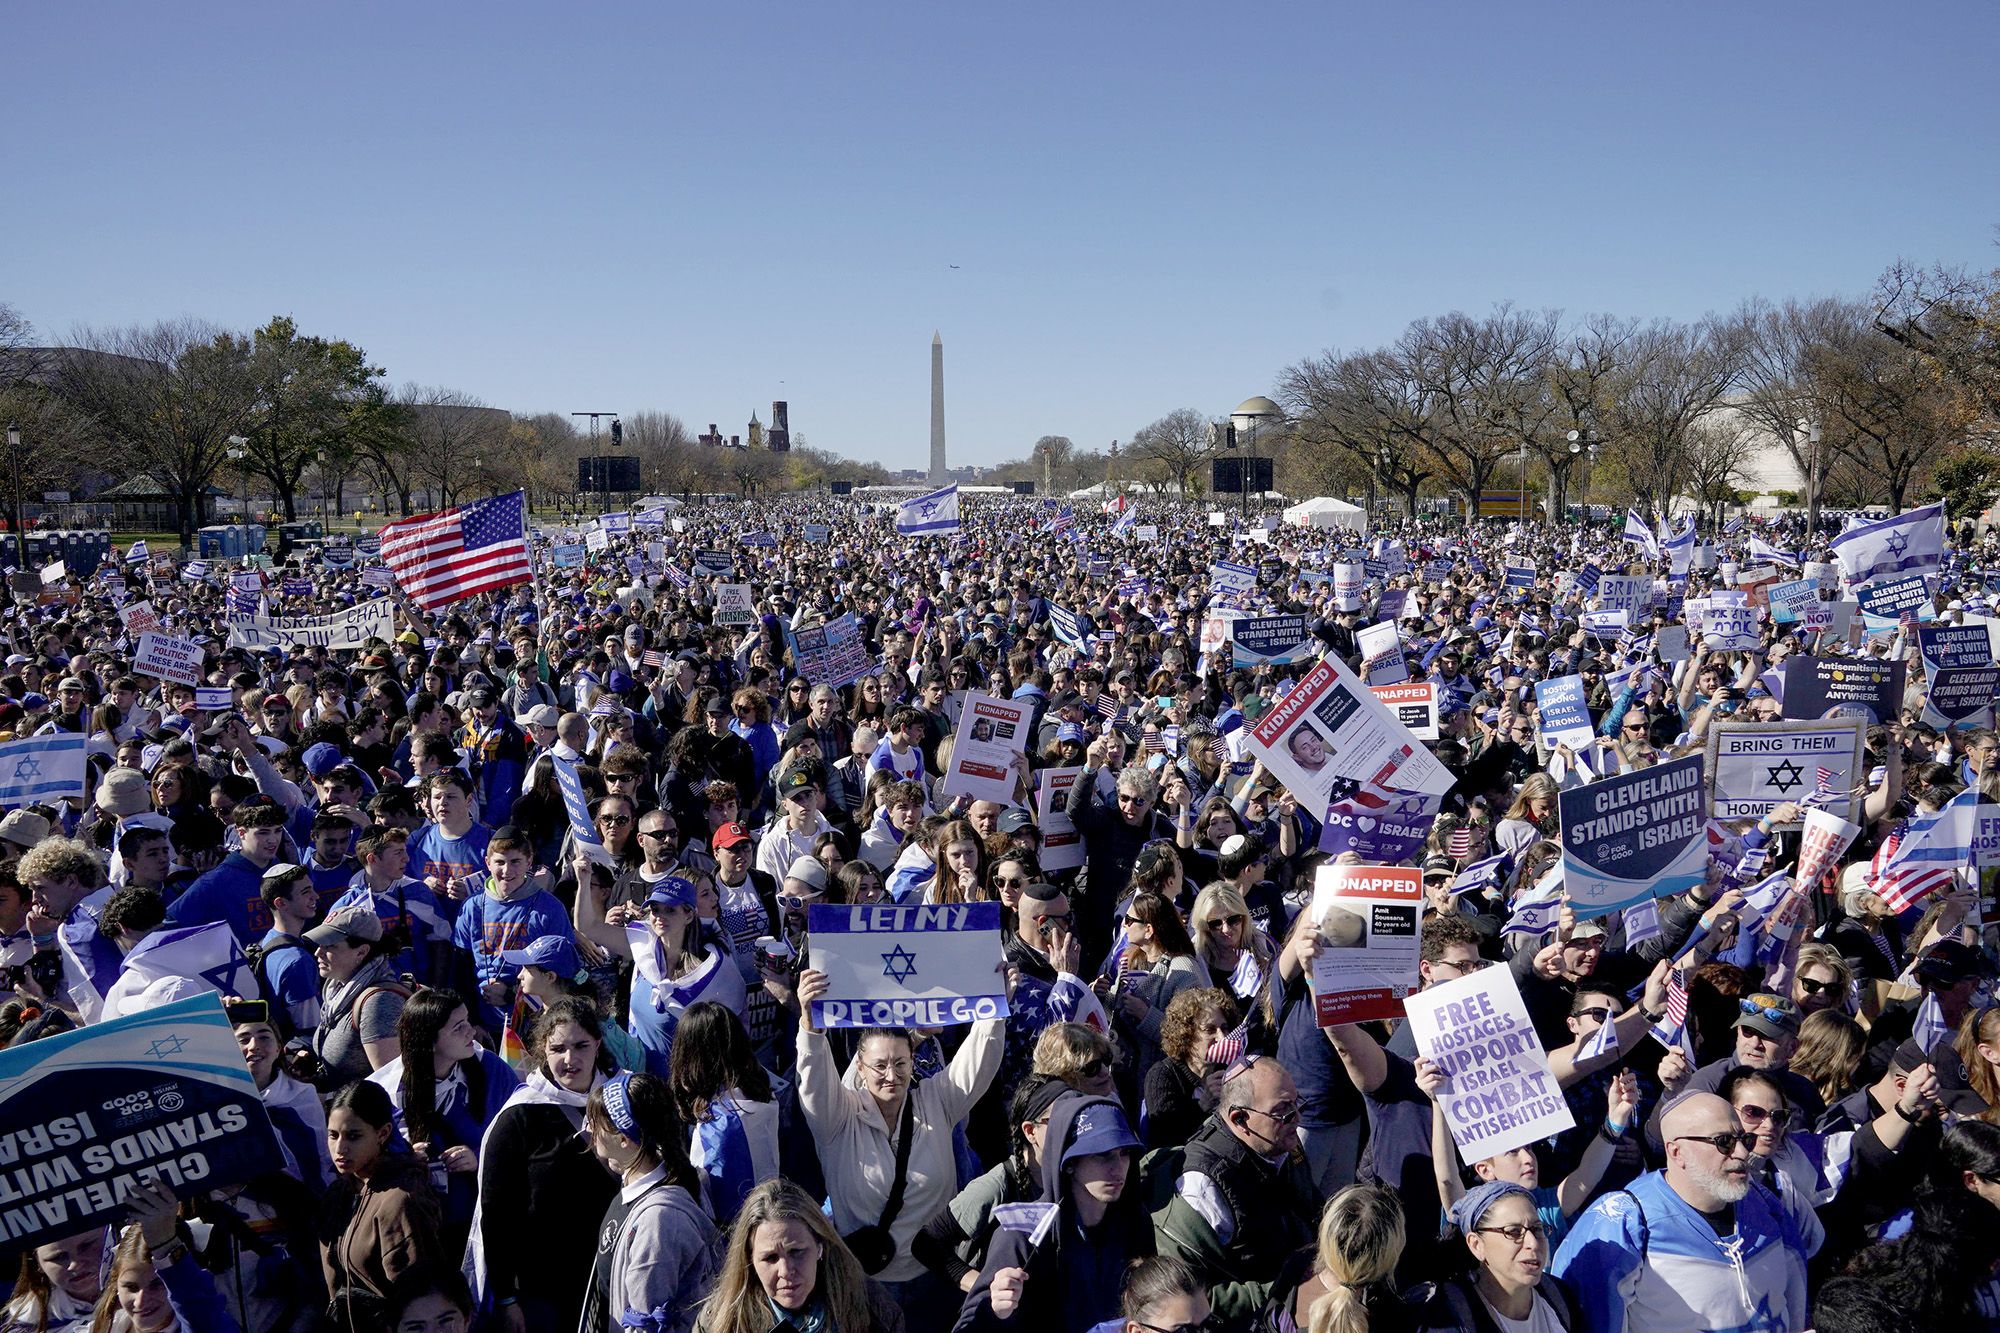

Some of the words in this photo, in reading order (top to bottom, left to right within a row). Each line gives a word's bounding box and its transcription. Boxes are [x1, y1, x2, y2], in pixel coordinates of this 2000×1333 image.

[1602, 580, 1651, 595] BRING
[1772, 580, 1811, 600] CLEVELAND
[1872, 579, 1923, 598] CLEVELAND
[720, 595, 745, 604] GAZA
[1786, 590, 1817, 607] STRONGER
[1863, 594, 1899, 609] STANDS
[1900, 588, 1926, 603] WITH
[347, 600, 390, 624] CHAI
[1788, 605, 1805, 615] THAN
[1249, 618, 1302, 630] CLEVELAND
[1807, 613, 1834, 624] NOW
[1237, 629, 1276, 640] STANDS
[1277, 627, 1302, 636] WITH
[1936, 629, 1987, 642] CLEVELAND
[151, 635, 169, 647] THIS
[170, 641, 179, 649] IS
[180, 643, 197, 654] NOT
[1964, 641, 1989, 653] WITH
[153, 646, 189, 661] POLITICS
[147, 654, 172, 667] THESE
[173, 661, 190, 671] ARE
[1816, 661, 1879, 672] Antisemitism
[1879, 664, 1891, 673] has
[136, 661, 166, 675] HUMAN
[167, 669, 196, 683] RIGHTS
[1845, 674, 1870, 682] place
[1949, 672, 1998, 683] CLEVELAND
[1372, 688, 1428, 699] DNAPPED
[1542, 682, 1576, 696] BOSTON
[1830, 682, 1866, 692] campus
[1933, 684, 1969, 697] STANDS
[1969, 683, 1994, 695] WITH
[1260, 666, 1330, 740] KIDNAPPED
[1543, 693, 1579, 707] STRONG.
[1825, 691, 1880, 701] ANYWHERE.
[977, 705, 1019, 719] KIDNAPPED
[1547, 705, 1578, 717] ISRAEL
[1546, 715, 1585, 729] STRONG.
[1730, 738, 1783, 752] BRING
[1792, 736, 1836, 749] THEM
[1595, 766, 1698, 813] CLEVELAND
[1727, 803, 1775, 815] HOME
[1329, 812, 1353, 828] DC
[1379, 822, 1425, 839] ISRAEL
[1571, 805, 1649, 845] STANDS
[1651, 790, 1699, 822] WITH
[1806, 824, 1848, 853] FREE
[1611, 844, 1627, 854] FOR
[1611, 849, 1633, 861] GOOD
[1338, 877, 1417, 893] DNAPPED
[850, 906, 914, 931] LET
[914, 905, 969, 931] MY
[1321, 996, 1338, 1005] Please
[823, 1000, 948, 1027] PEOPLE
[951, 997, 997, 1021] GO
[1433, 991, 1496, 1031] FREE
[1430, 1012, 1516, 1055] HOSTAGES
[1436, 1026, 1537, 1078] UPPORT
[1459, 1059, 1522, 1093] ISRAEL
[102, 1090, 149, 1112] GOOD
[1451, 1070, 1549, 1125] COMBAT
[121, 1099, 154, 1117] FOR
[1452, 1094, 1570, 1147] ANTISEMITISM
[81, 1104, 248, 1176] STANDS
[0, 1152, 211, 1243] CLEVELAN
